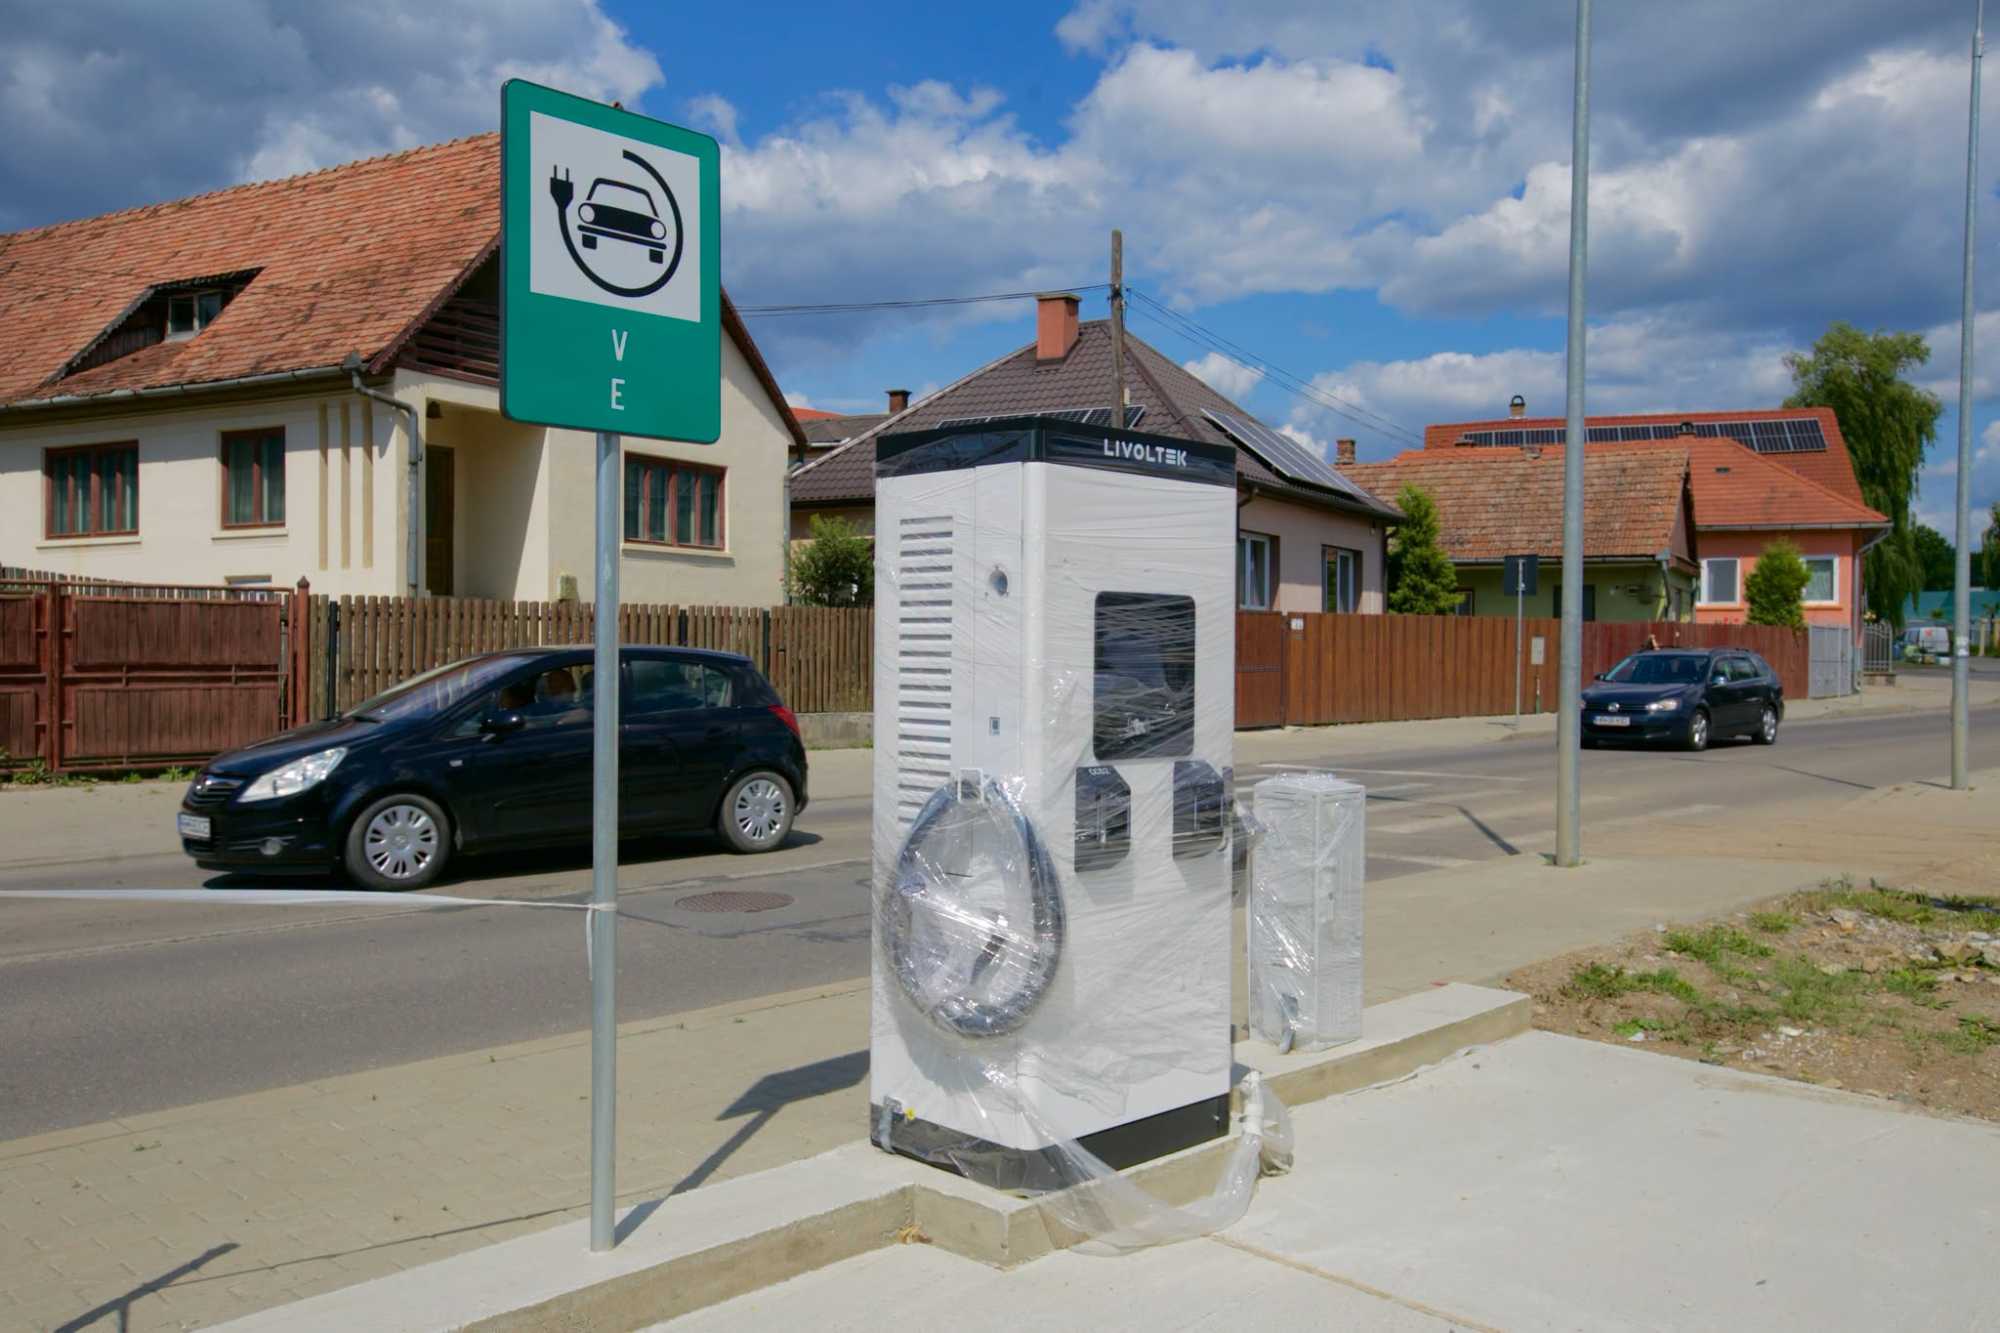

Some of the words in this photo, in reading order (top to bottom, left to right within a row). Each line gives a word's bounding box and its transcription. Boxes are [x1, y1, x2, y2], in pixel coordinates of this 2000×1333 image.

[611, 328, 628, 361] V
[611, 378, 626, 410] E
[1103, 438, 1187, 467] LIVOLTEK
